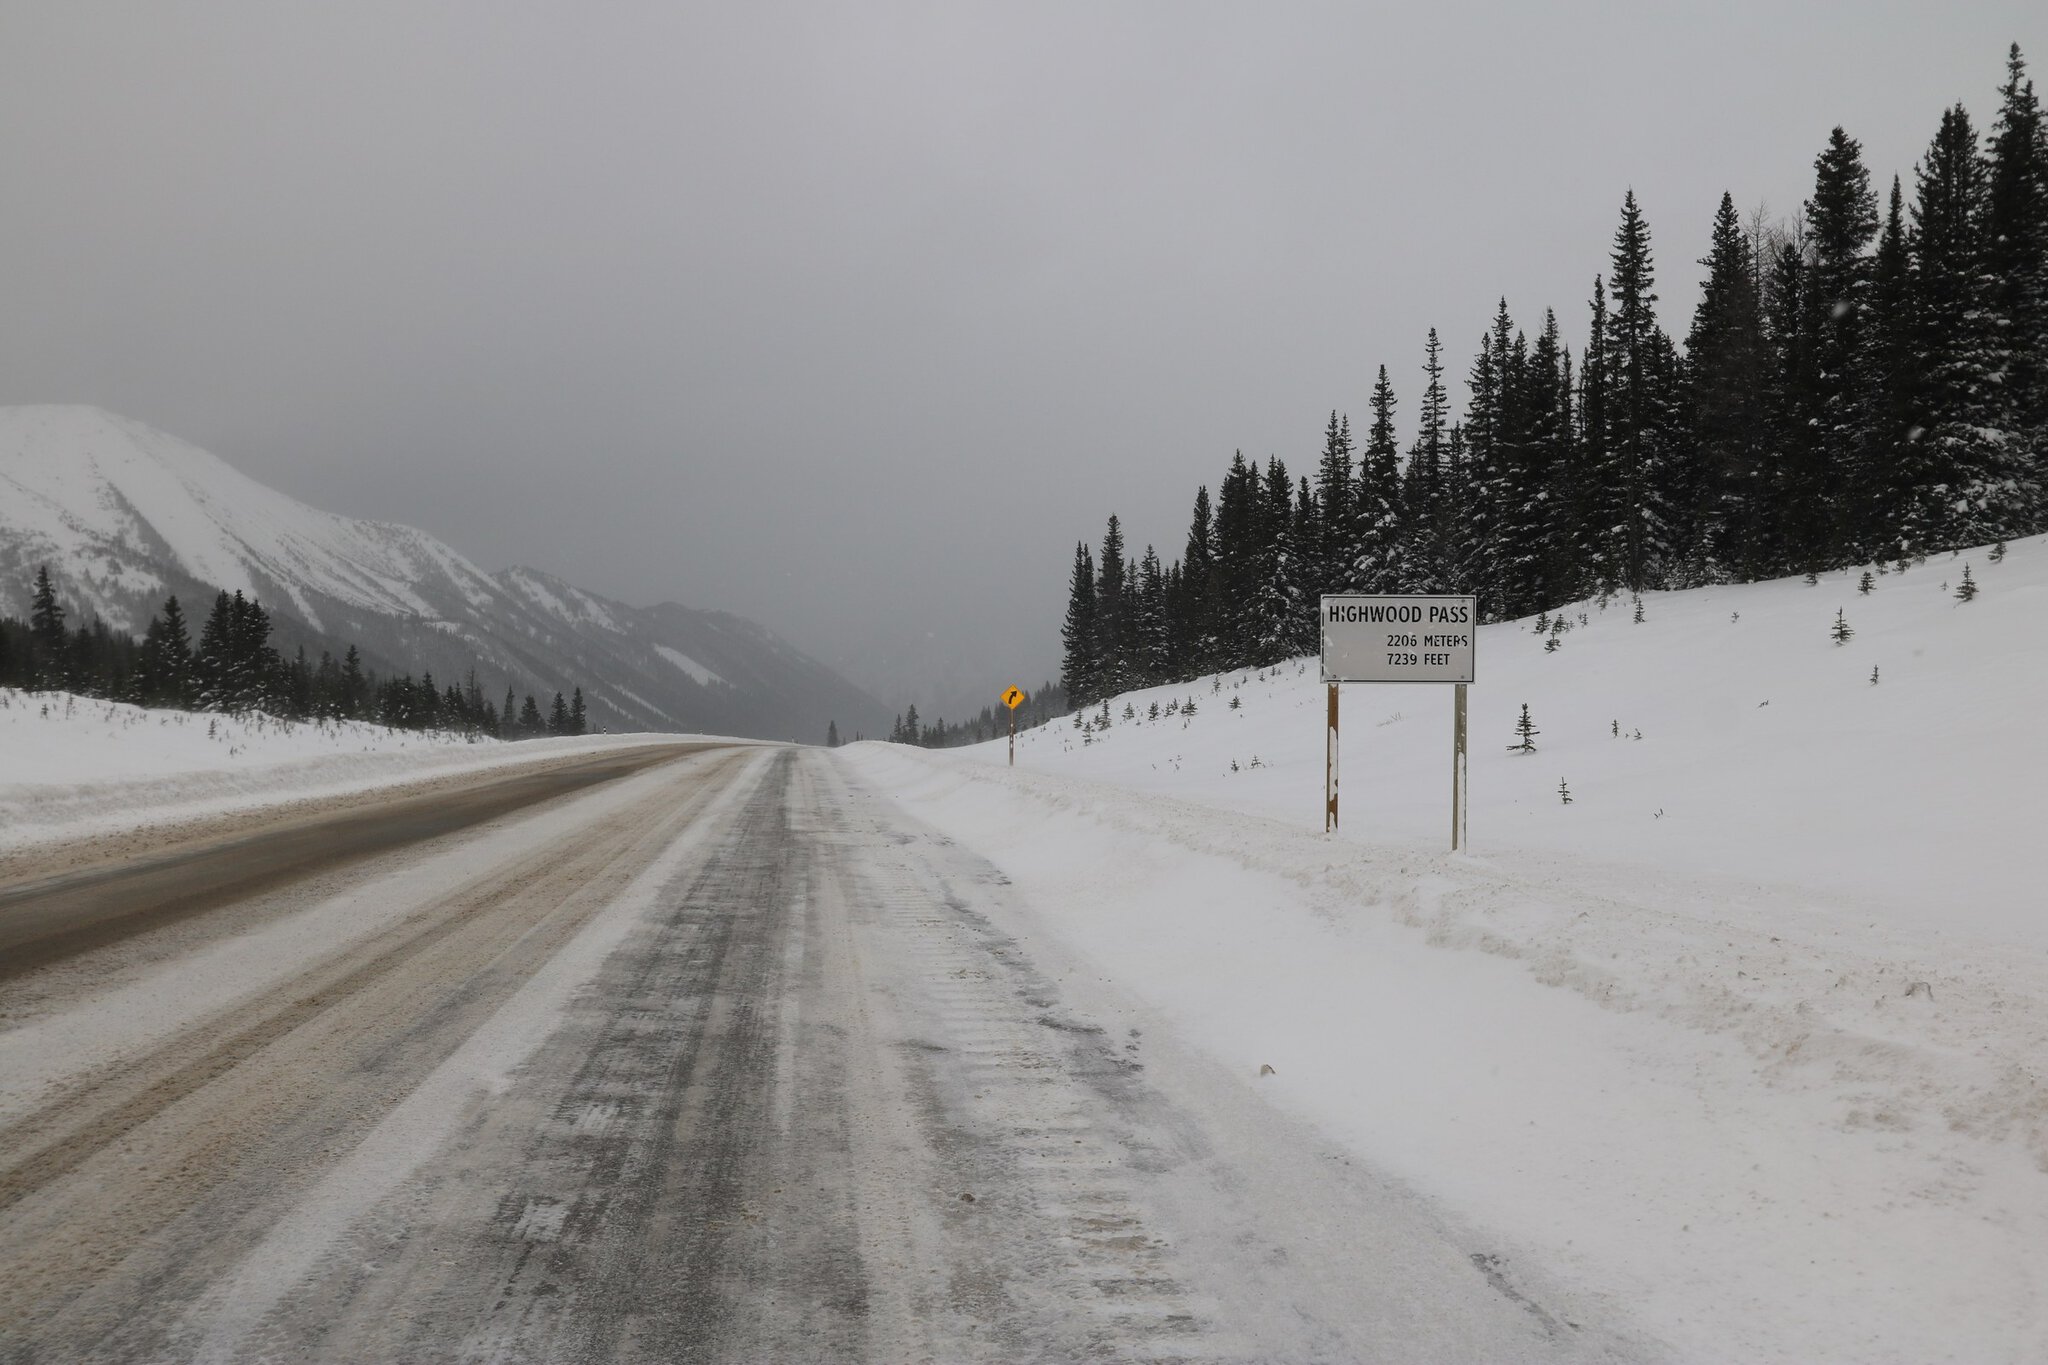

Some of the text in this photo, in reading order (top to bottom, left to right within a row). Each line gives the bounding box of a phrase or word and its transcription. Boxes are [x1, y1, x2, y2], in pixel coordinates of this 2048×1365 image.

[1329, 606, 1468, 623] HIGHWOOD PASS
[1387, 635, 1468, 647] 2206 METERS
[1387, 653, 1450, 665] 7239 FEET
